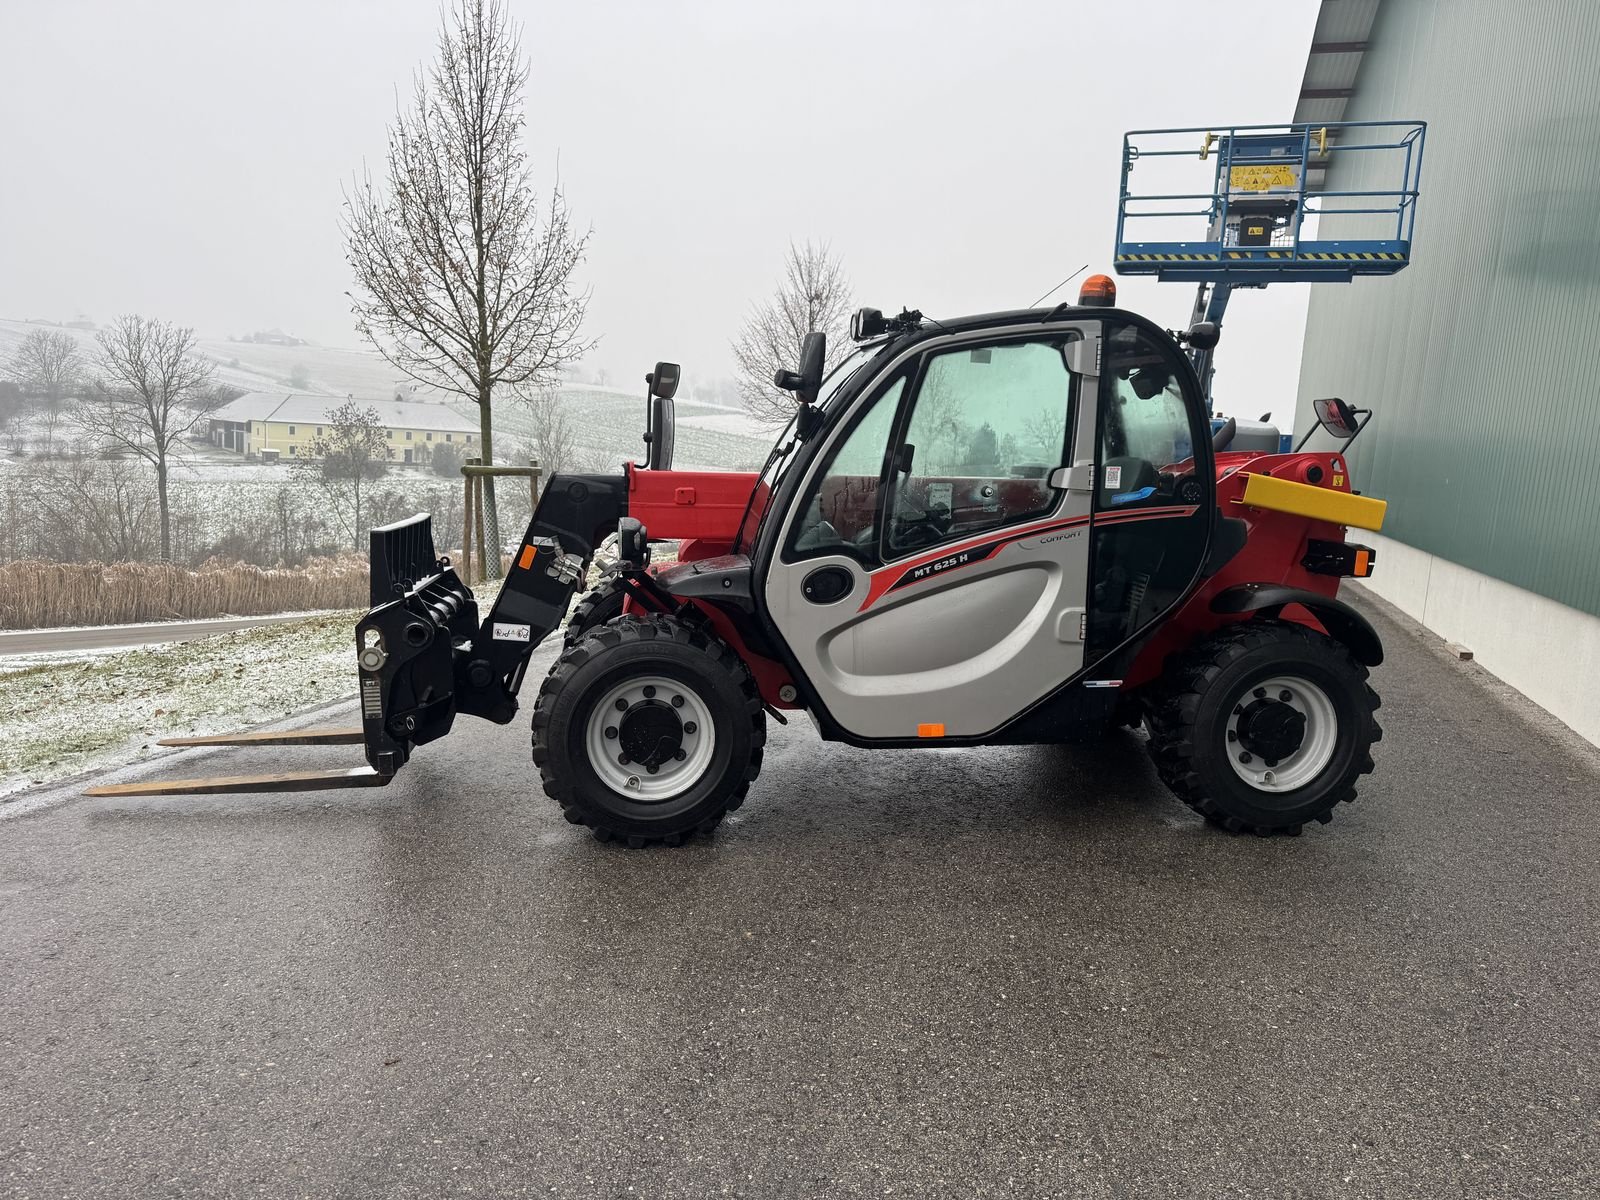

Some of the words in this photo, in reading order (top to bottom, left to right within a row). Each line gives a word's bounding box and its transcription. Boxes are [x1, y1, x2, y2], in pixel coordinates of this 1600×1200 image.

[914, 565, 932, 578] MT
[933, 557, 957, 571] 625
[959, 553, 968, 563] H
